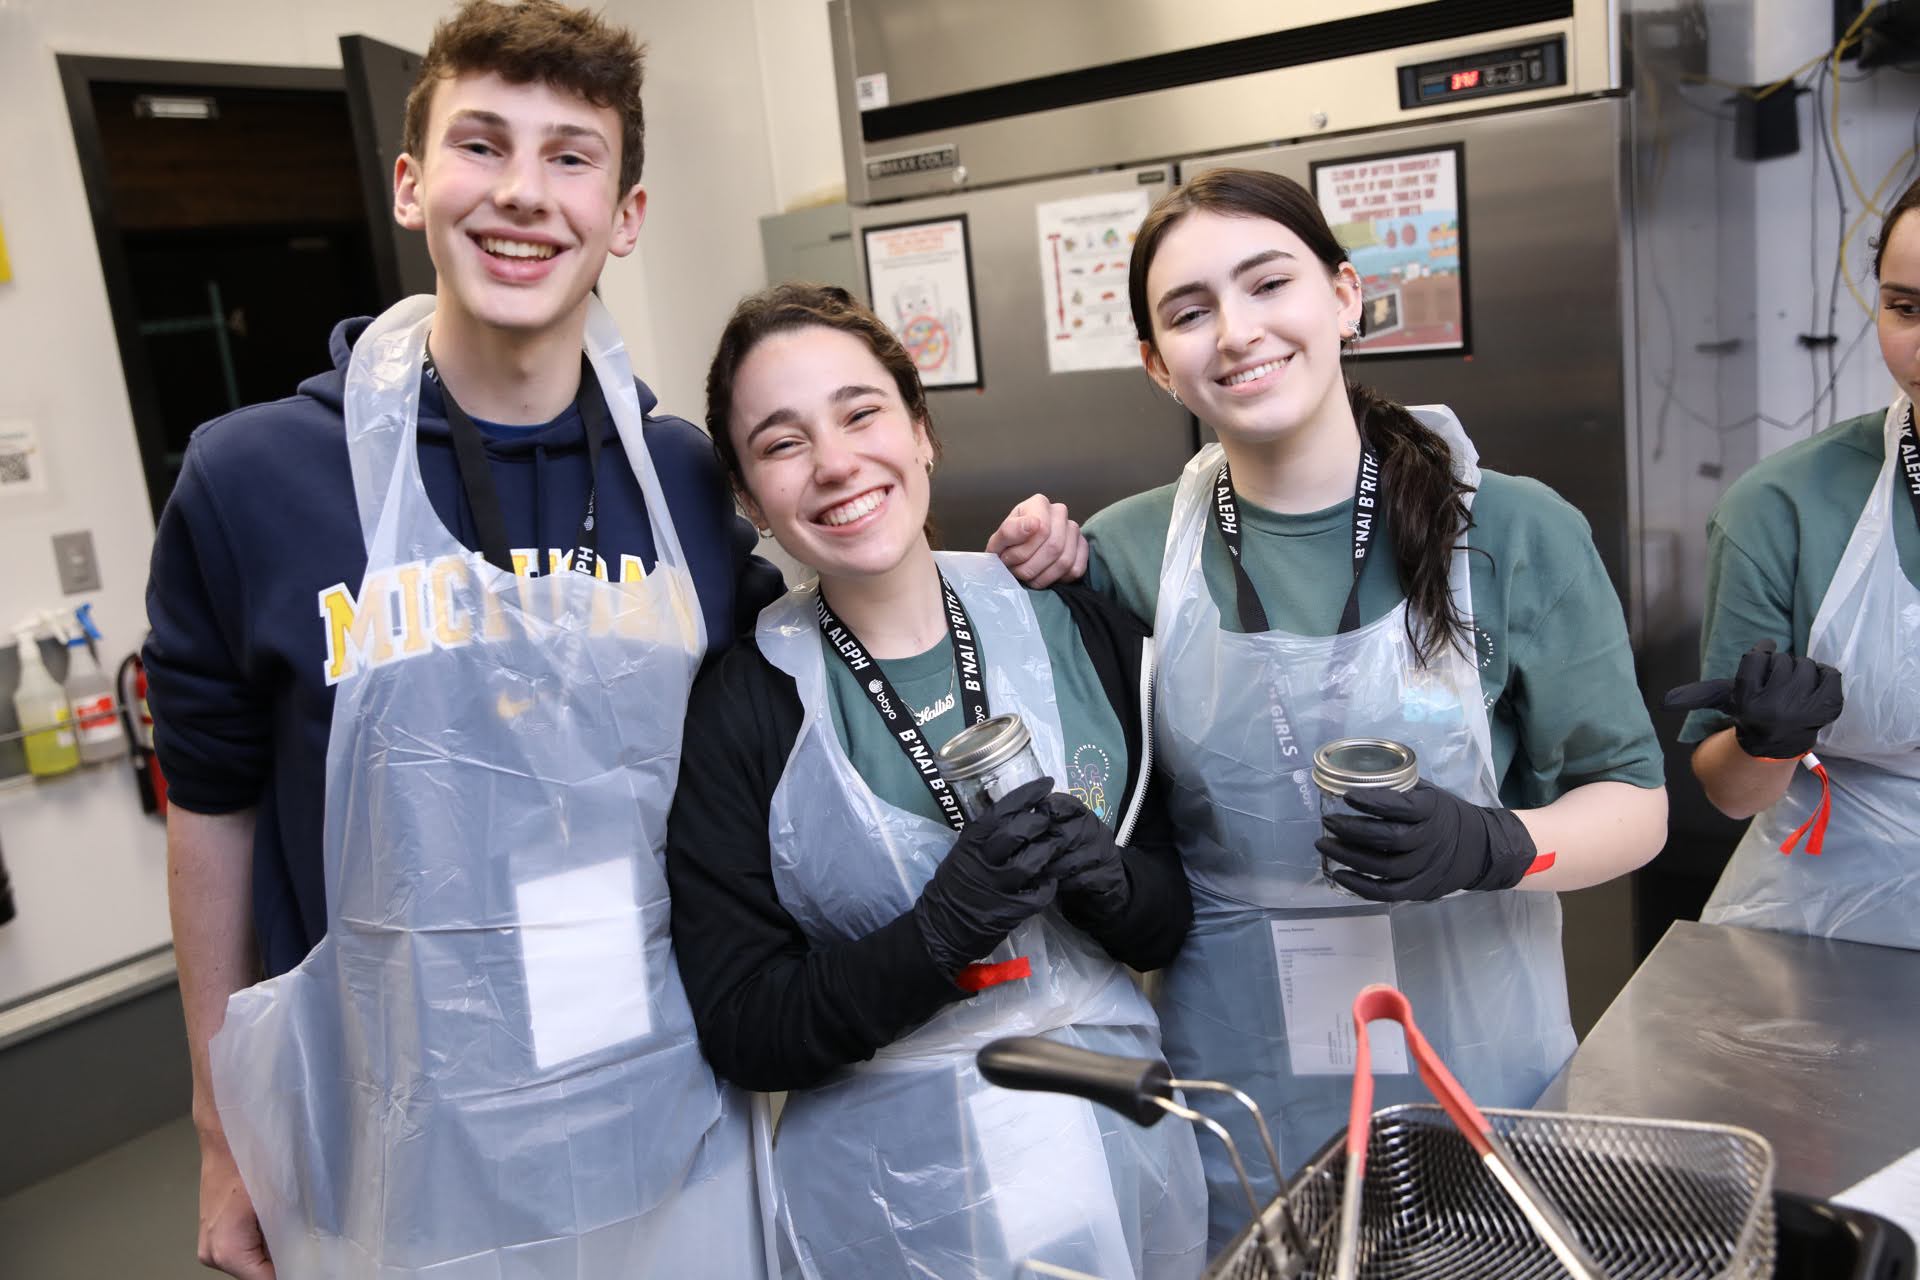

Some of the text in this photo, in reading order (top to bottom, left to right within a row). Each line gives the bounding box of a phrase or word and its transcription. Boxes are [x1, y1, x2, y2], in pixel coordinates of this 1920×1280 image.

[1218, 486, 1238, 535] ALEPH
[1355, 513, 1373, 559] B'NAI
[947, 593, 971, 641] B'RITH
[961, 644, 981, 692] B'NAI
[828, 627, 870, 671] ALEPH
[876, 691, 897, 720] bbyo
[898, 728, 938, 775] B'NAI
